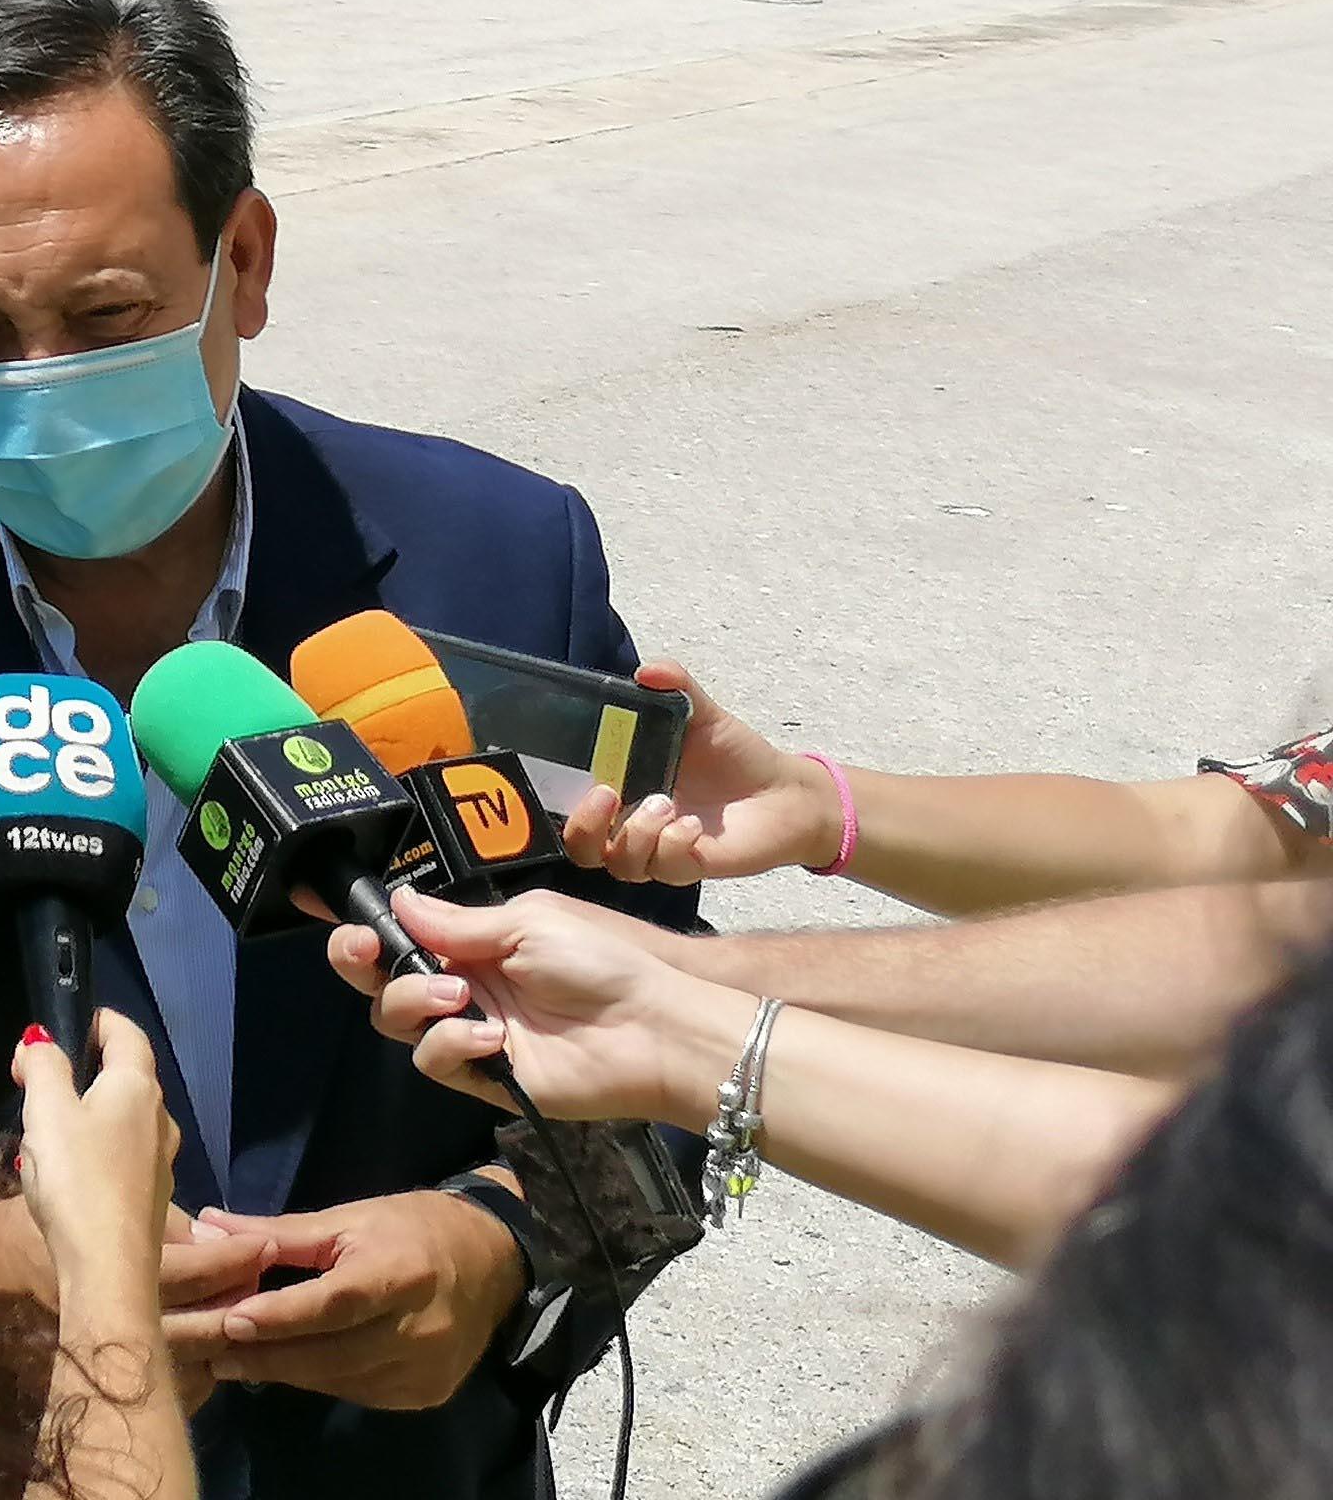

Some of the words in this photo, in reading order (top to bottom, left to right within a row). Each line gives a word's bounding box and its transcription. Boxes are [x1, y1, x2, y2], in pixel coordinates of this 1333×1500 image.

[303, 783, 381, 811] radio.com
[451, 788, 509, 830] TV
[6, 826, 104, 856] 12tv.es
